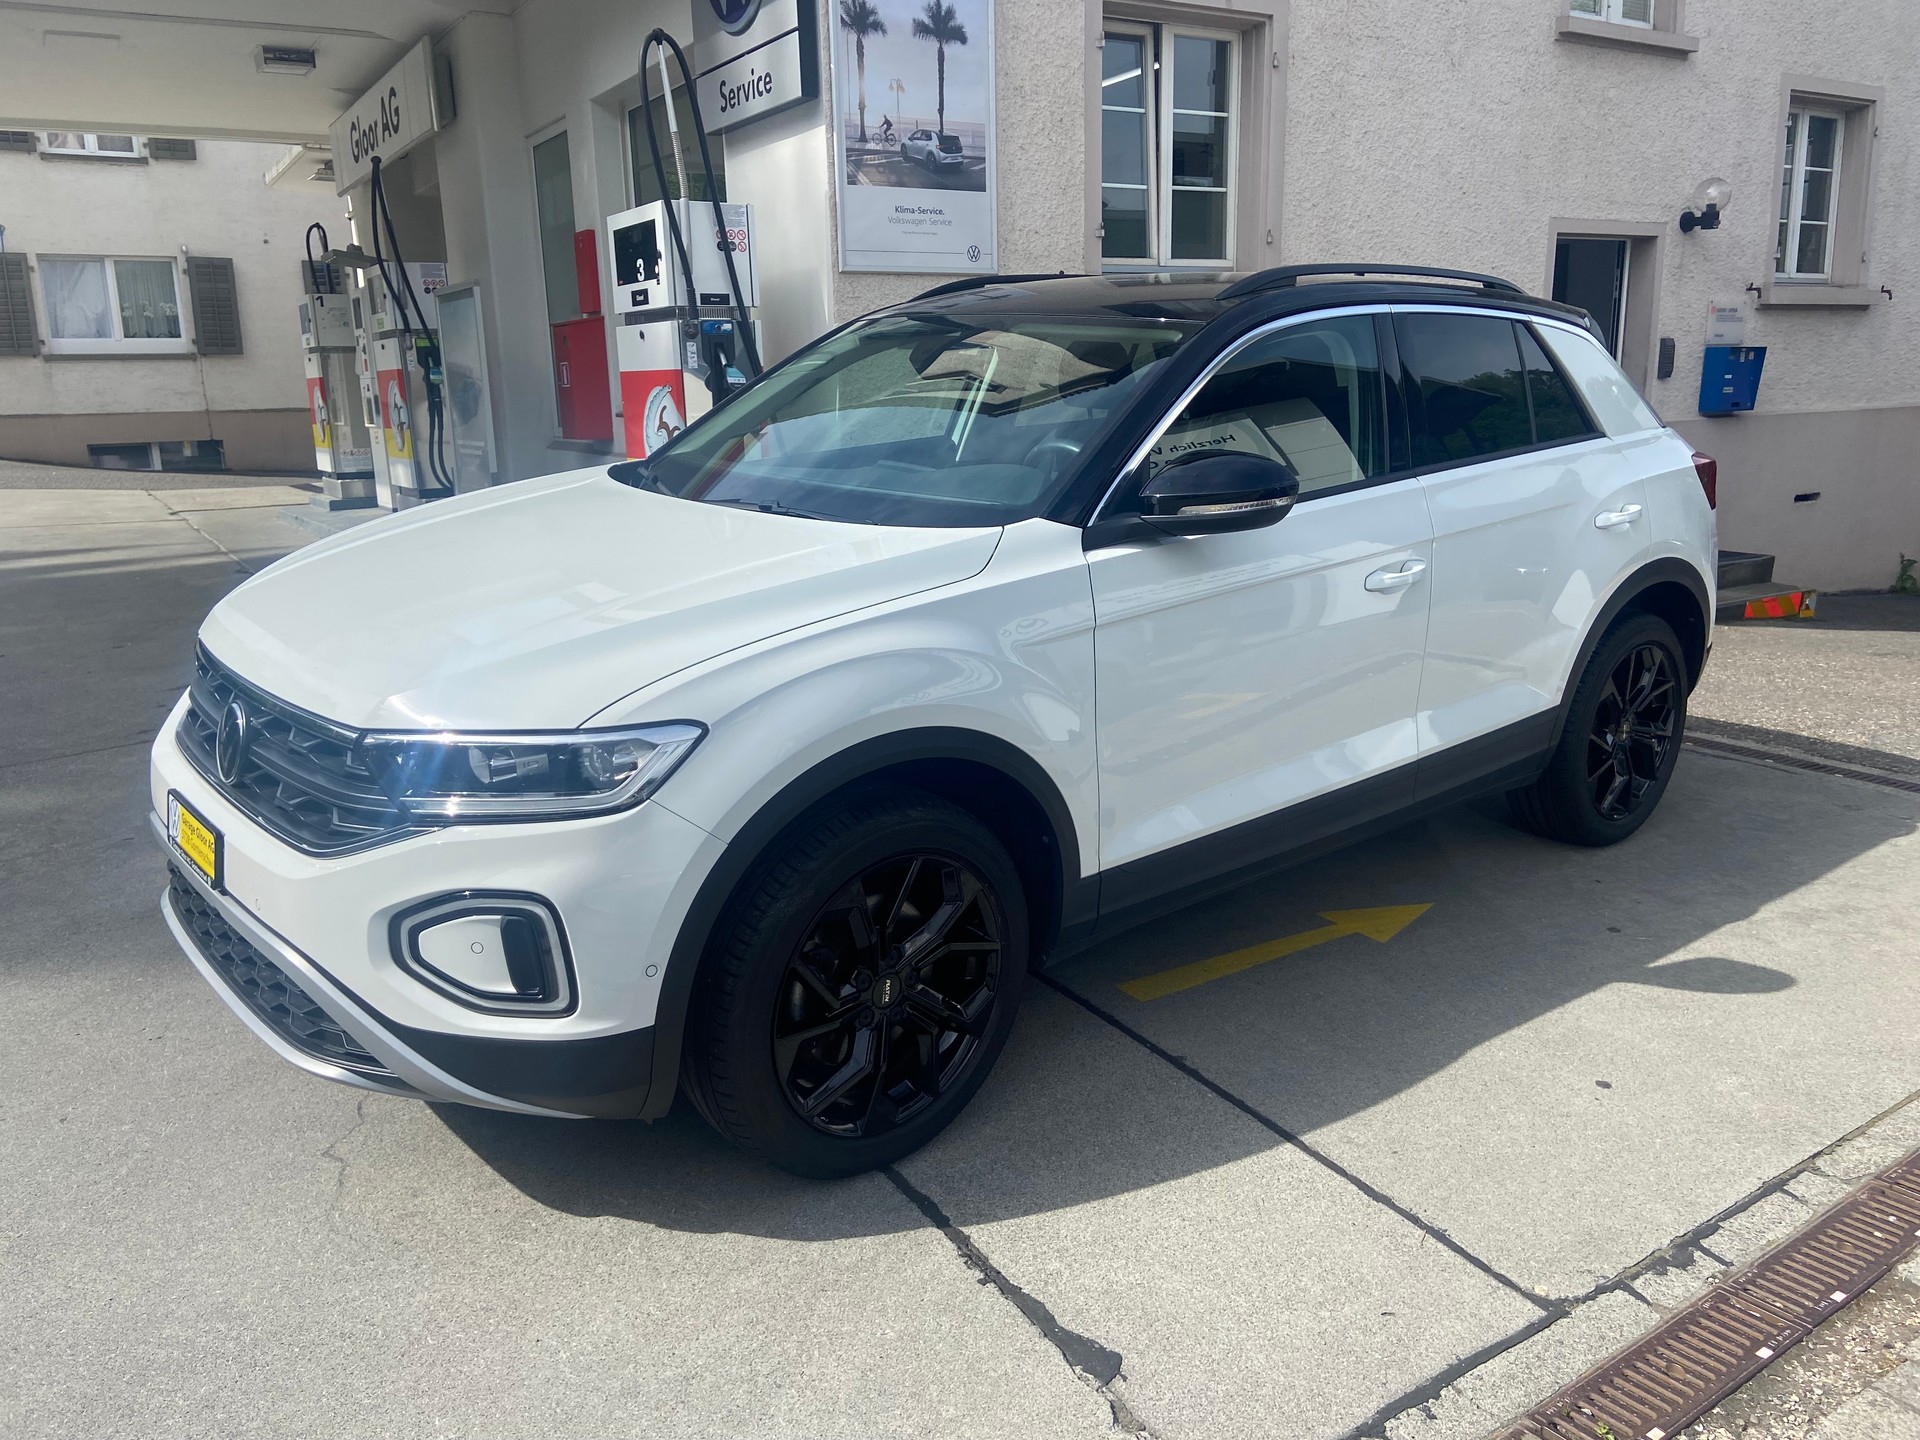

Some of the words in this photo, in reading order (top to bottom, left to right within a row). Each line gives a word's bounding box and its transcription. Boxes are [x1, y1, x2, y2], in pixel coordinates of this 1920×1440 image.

[720, 68, 772, 113] Service
[350, 115, 379, 164] Gloor
[381, 86, 400, 143] AG
[895, 205, 945, 216] Klima-Service.
[888, 216, 927, 227] Volkswagen
[929, 218, 953, 227] Service
[636, 258, 645, 281] 3
[315, 295, 325, 308] 1
